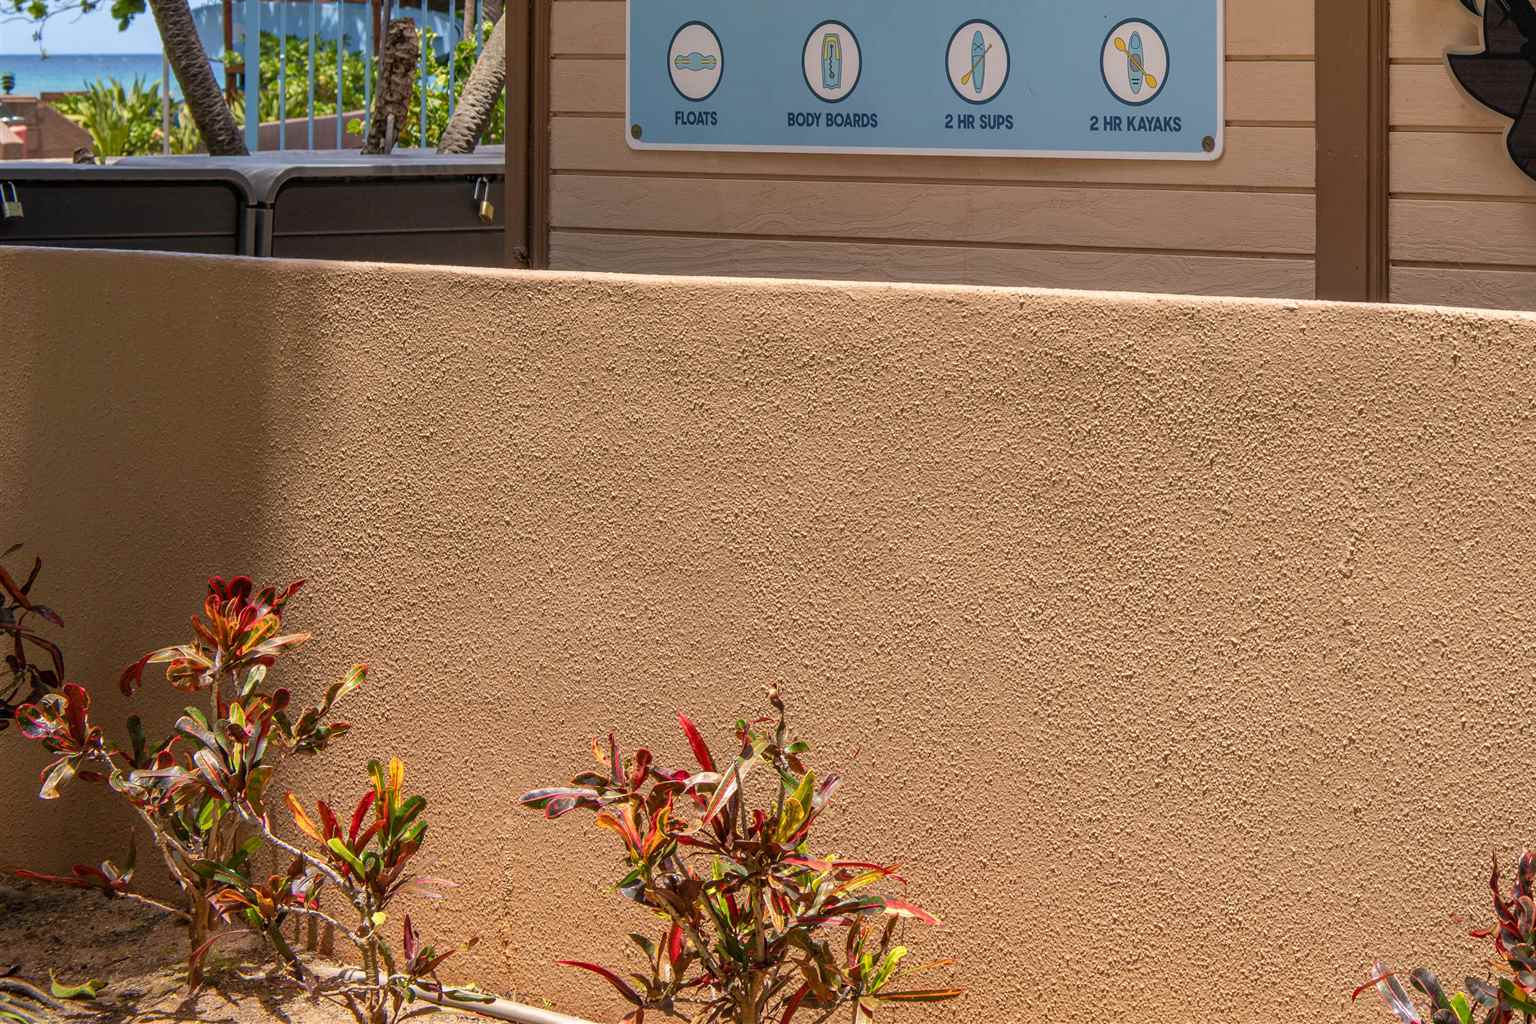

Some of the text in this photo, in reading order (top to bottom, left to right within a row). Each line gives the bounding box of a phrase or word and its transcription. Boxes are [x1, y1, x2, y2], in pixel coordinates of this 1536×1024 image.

[675, 111, 717, 125] FLOATS
[788, 112, 877, 128] BODY BOARDS
[945, 114, 1013, 129] 2 HR SUPS
[1090, 116, 1181, 132] 2 HR KAYAKS
